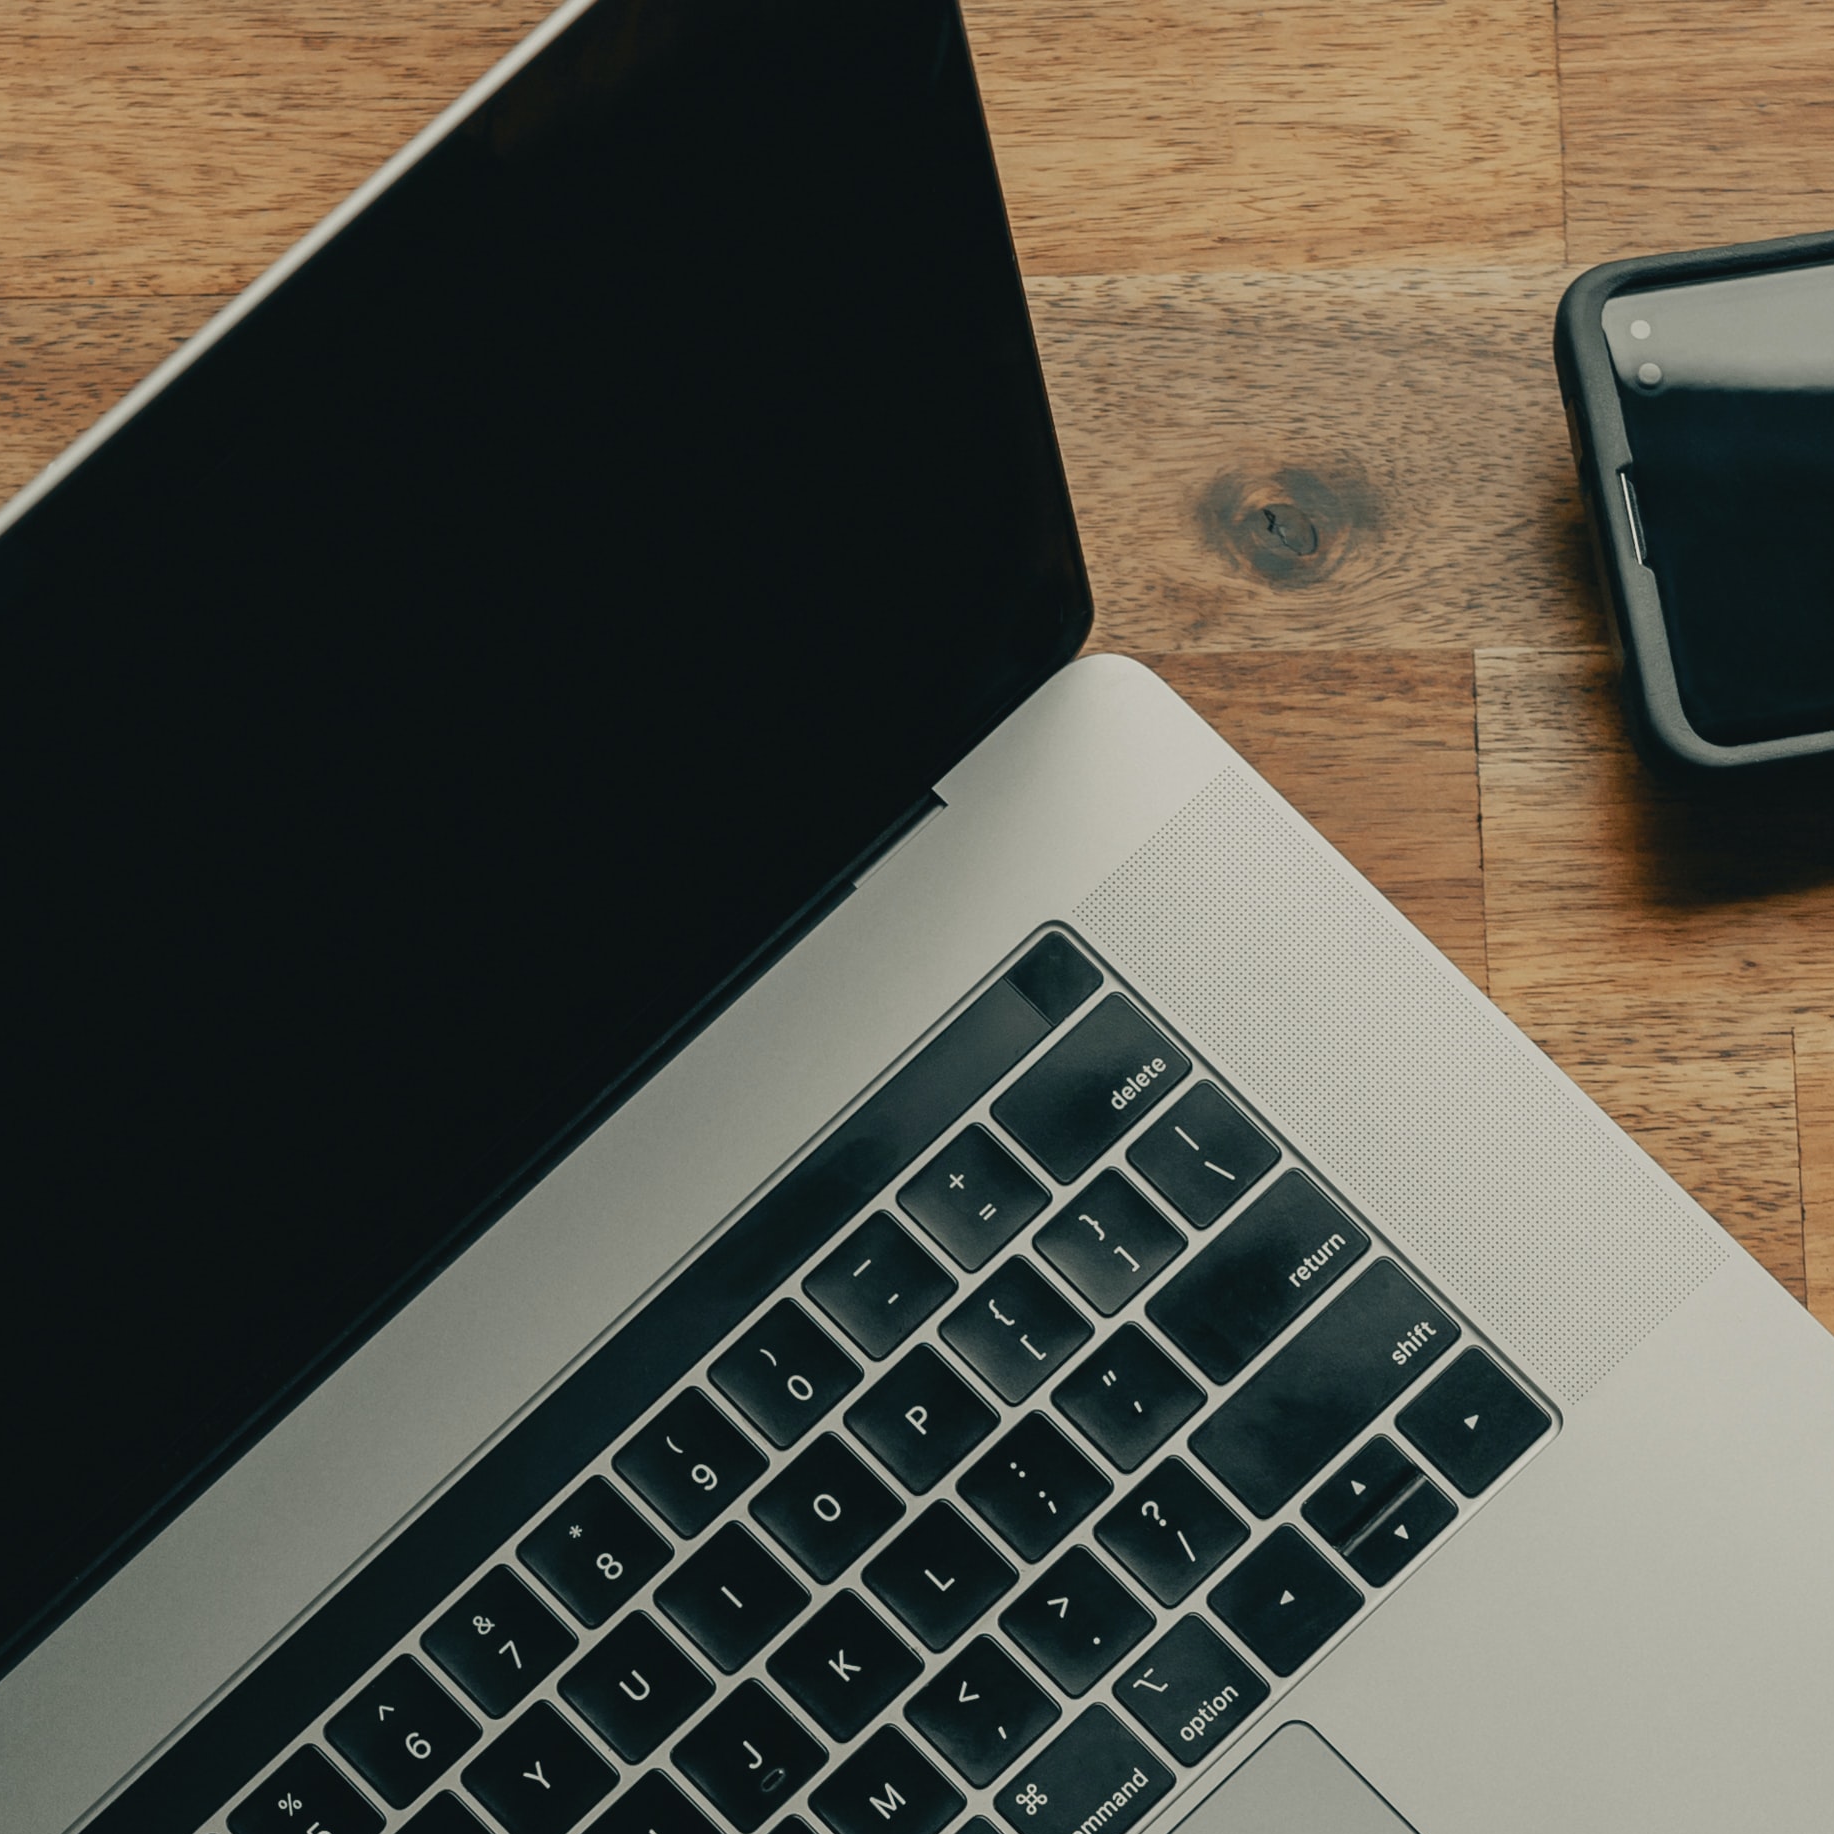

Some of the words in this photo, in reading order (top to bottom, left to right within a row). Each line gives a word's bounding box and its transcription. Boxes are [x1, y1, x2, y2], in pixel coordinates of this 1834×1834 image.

[1110, 1057, 1167, 1111] delete
[948, 1173, 965, 1190] +
[978, 1202, 998, 1221] =
[1288, 1233, 1347, 1288] return
[1391, 1321, 1438, 1366] shift
[786, 1374, 814, 1401] 0
[904, 1405, 928, 1436] P
[690, 1463, 719, 1492] 9
[812, 1493, 842, 1522] O
[1141, 1500, 1168, 1527] ?
[595, 1552, 624, 1581] 8
[923, 1568, 956, 1592] L
[720, 1585, 744, 1609] I
[472, 1615, 496, 1636] &
[498, 1639, 523, 1670] 7
[827, 1648, 862, 1683] K
[618, 1669, 651, 1701] U
[1179, 1685, 1240, 1742] option
[404, 1731, 432, 1760] 6
[742, 1740, 763, 1770] J
[522, 1760, 551, 1790] Y
[277, 1792, 303, 1817] %
[868, 1782, 907, 1820] M
